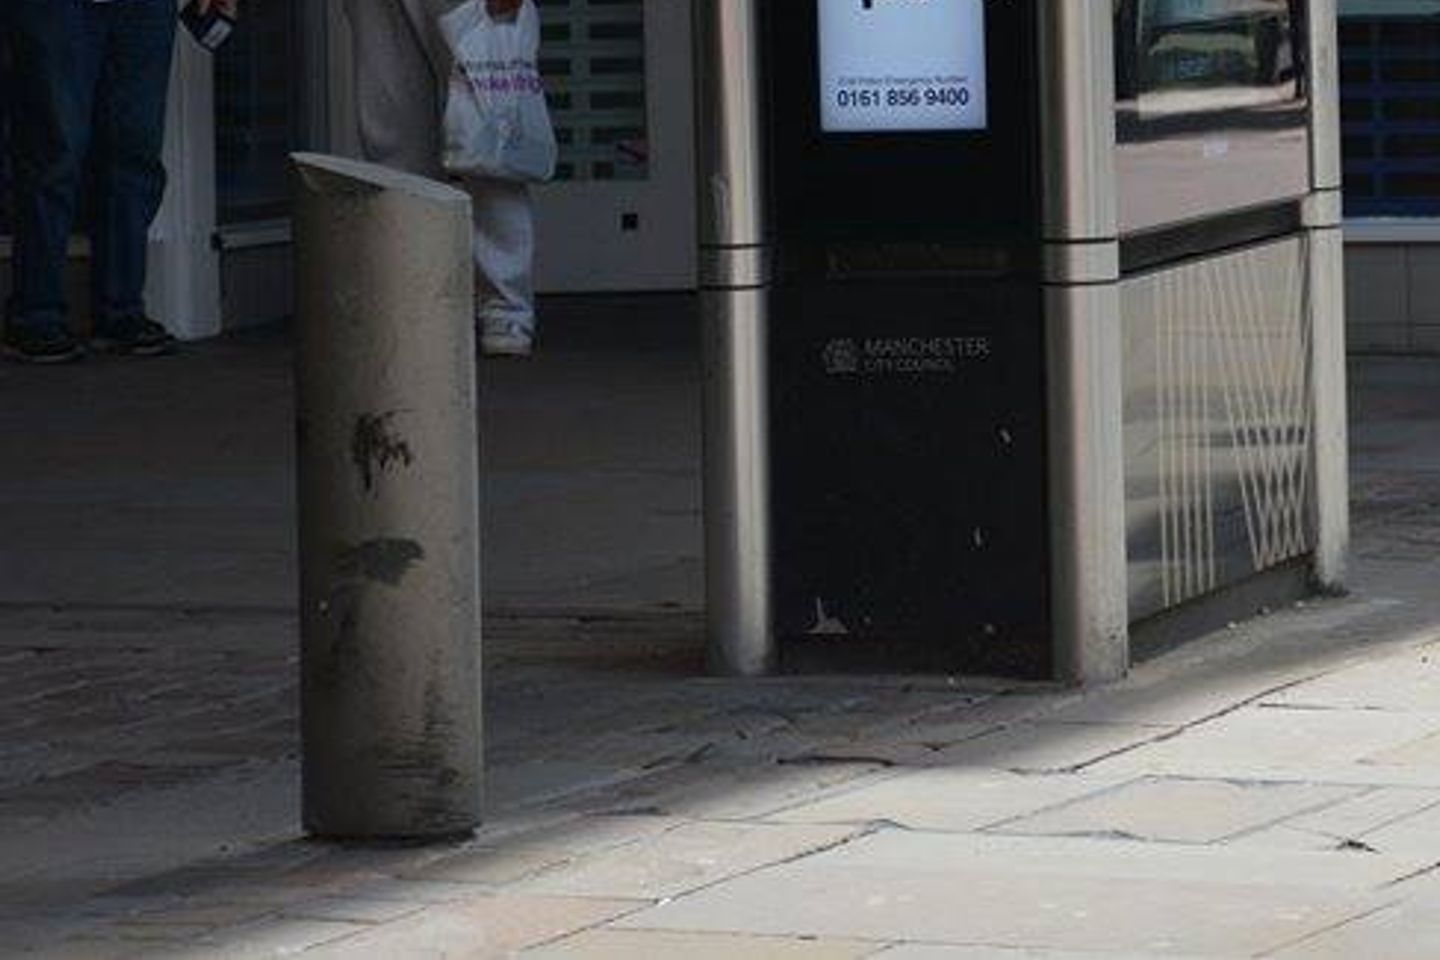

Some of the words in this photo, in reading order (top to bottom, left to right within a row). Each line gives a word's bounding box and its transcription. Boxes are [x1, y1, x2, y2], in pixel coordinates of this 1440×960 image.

[837, 89, 880, 107] 0161
[886, 87, 921, 107] 856
[923, 87, 970, 106] 9400
